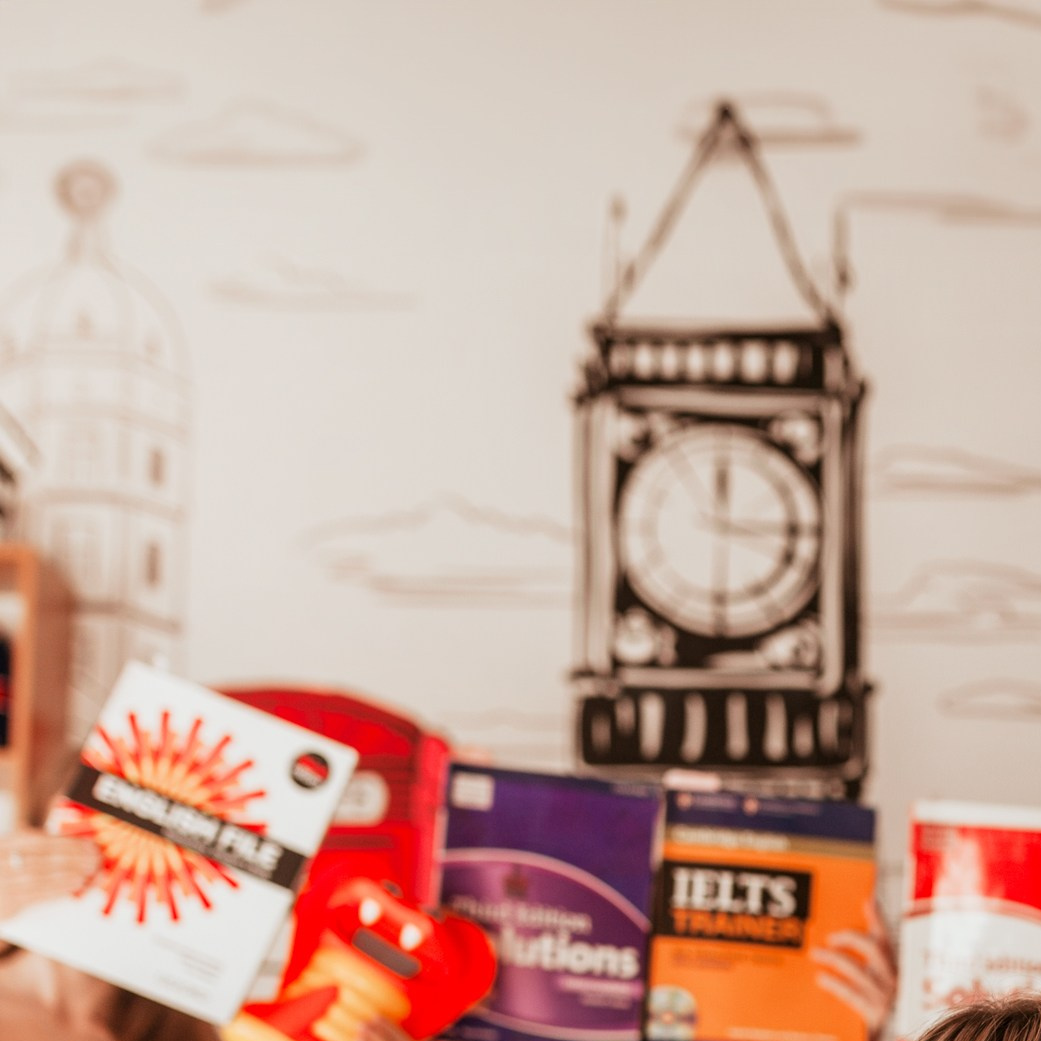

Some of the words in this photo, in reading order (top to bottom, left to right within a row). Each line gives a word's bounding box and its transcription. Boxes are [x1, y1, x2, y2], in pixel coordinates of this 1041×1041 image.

[92, 773, 221, 848] ENGLISH
[216, 822, 283, 871] FILE
[671, 866, 798, 918] IELTS
[498, 924, 640, 980] lutions
[672, 908, 803, 943] TRAINER
